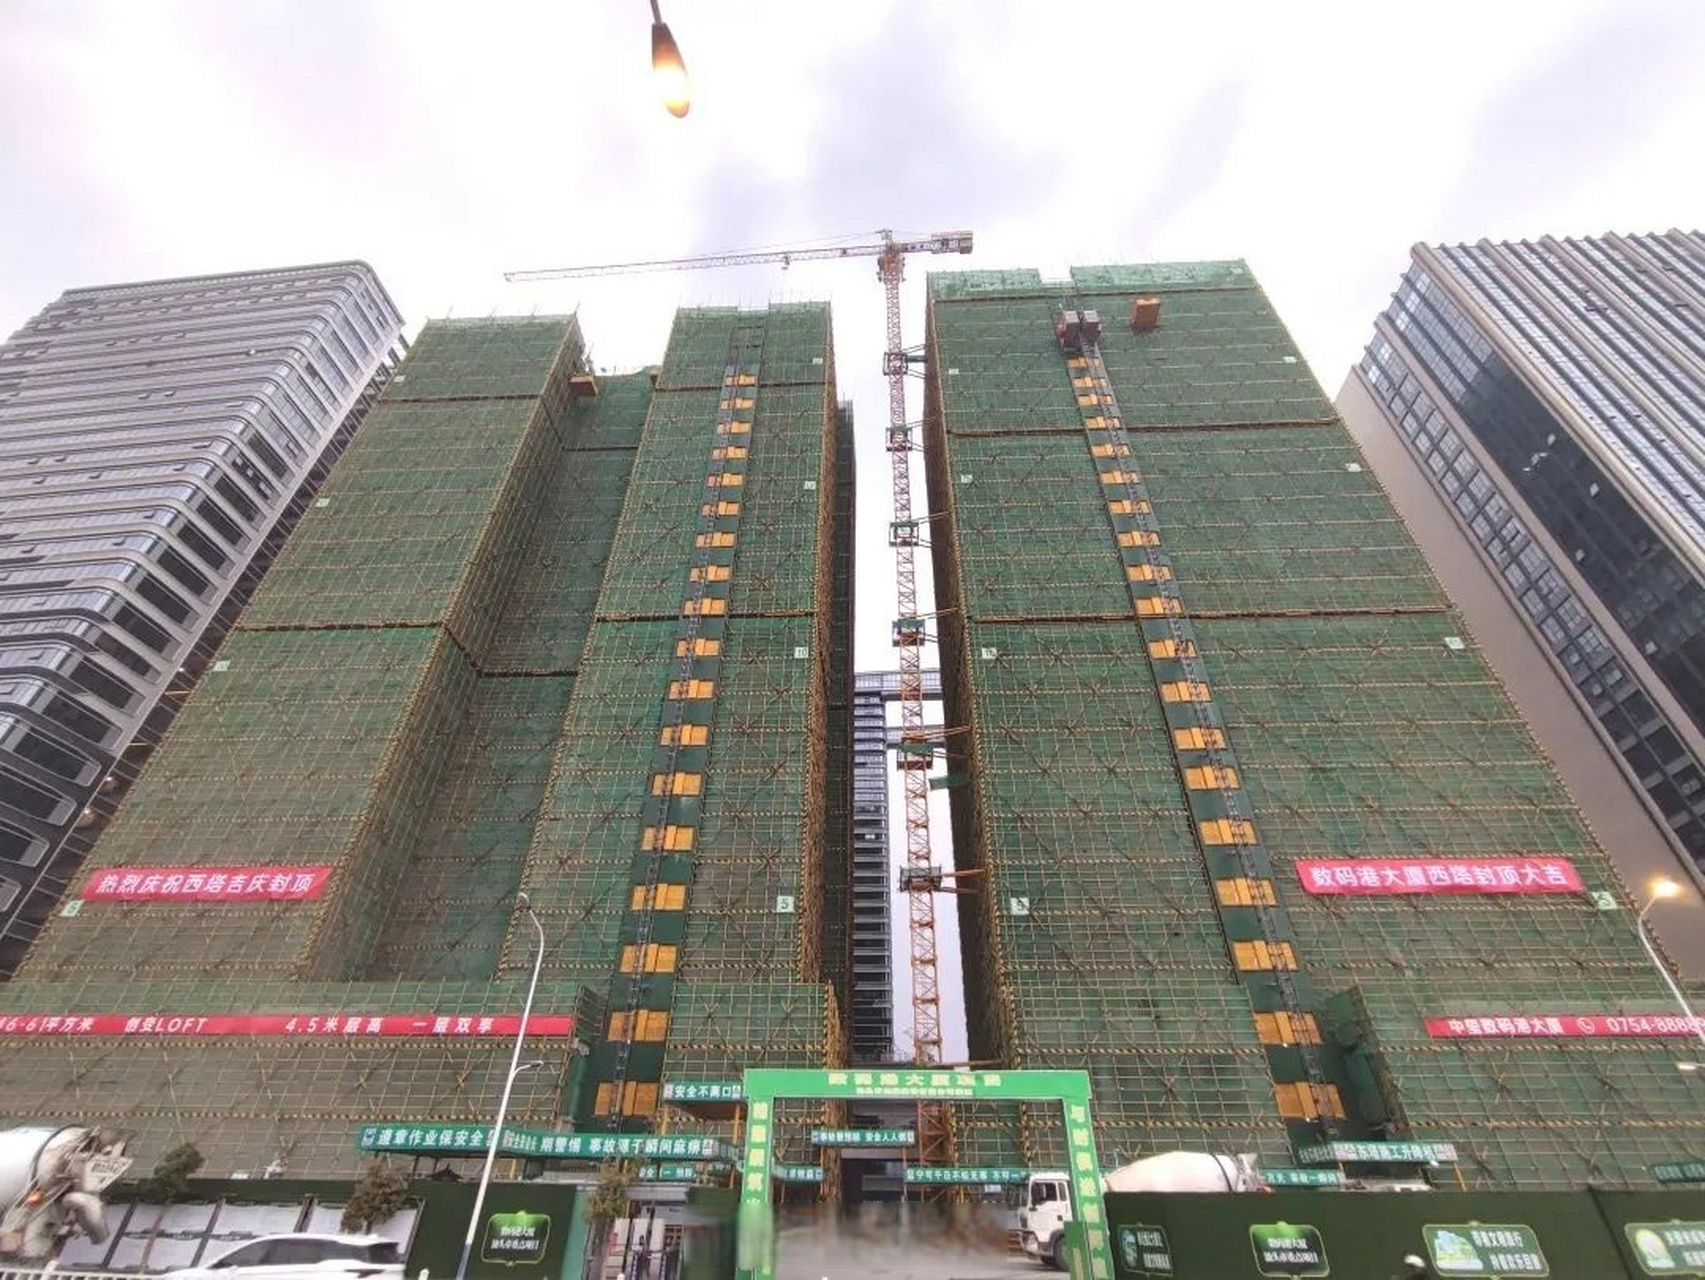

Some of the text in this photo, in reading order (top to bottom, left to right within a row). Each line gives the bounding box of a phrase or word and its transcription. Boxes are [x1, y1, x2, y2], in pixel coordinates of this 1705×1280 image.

[377, 1129, 484, 1147] 遵章作业保安全
